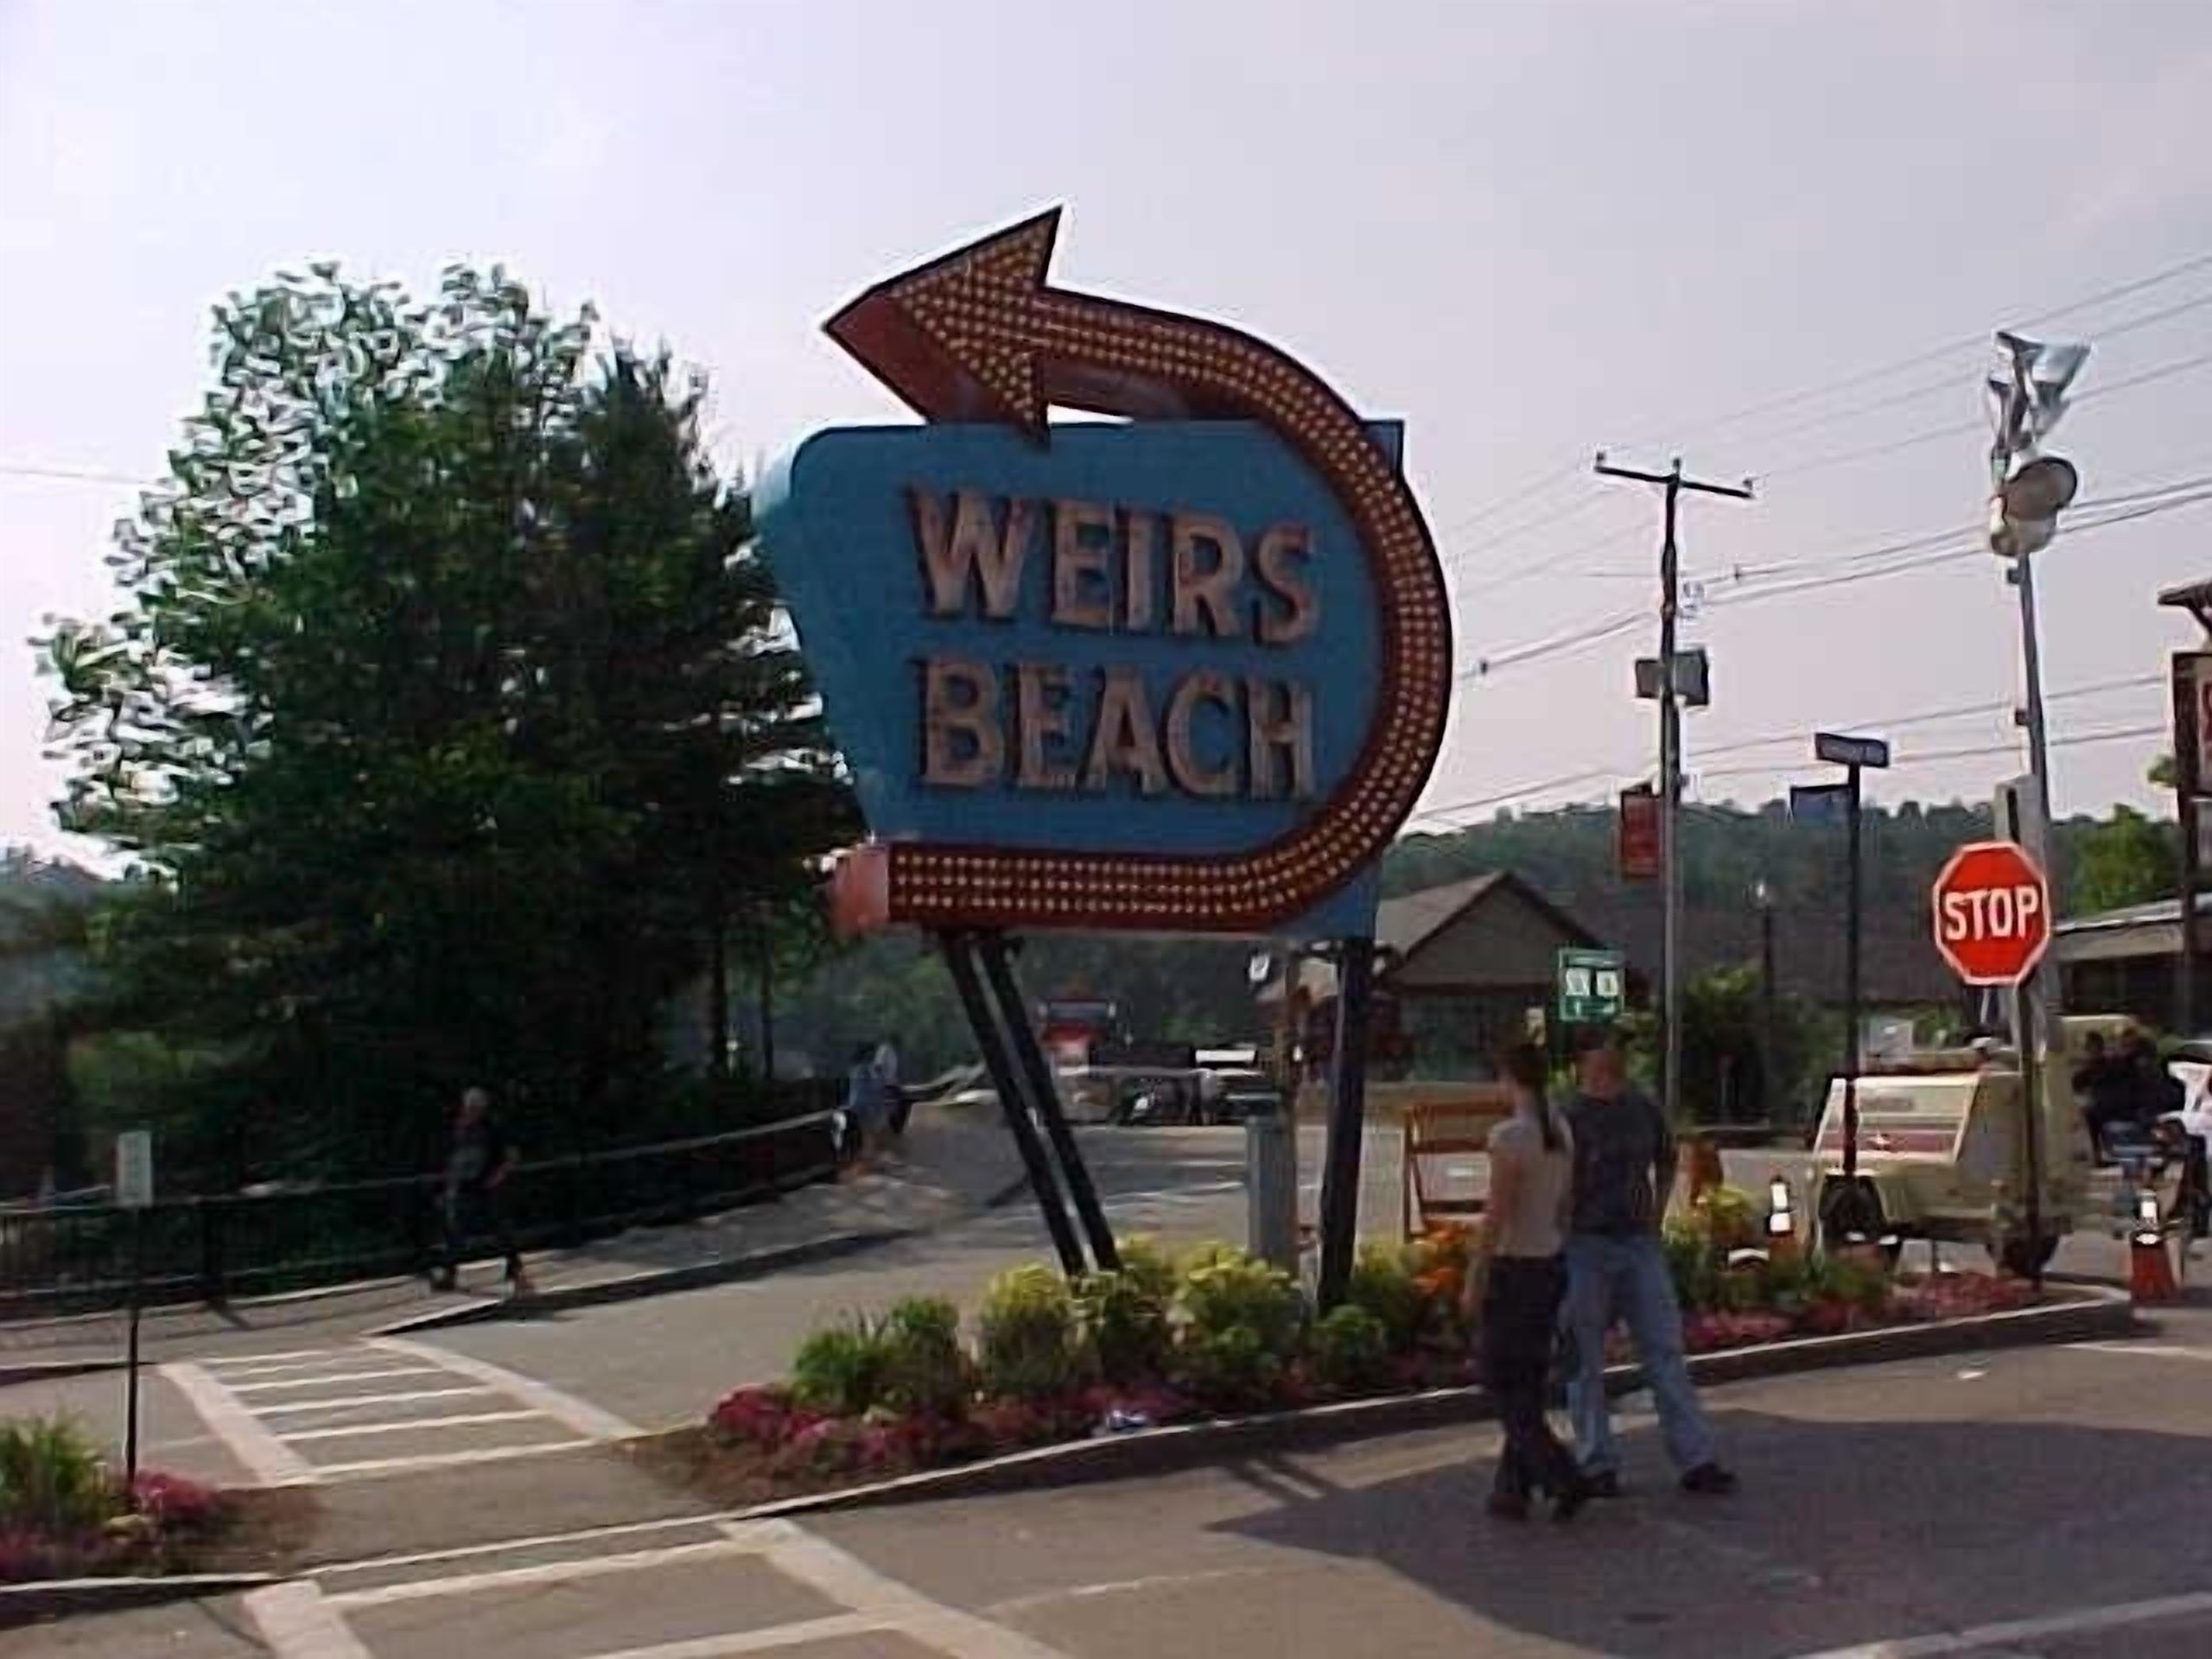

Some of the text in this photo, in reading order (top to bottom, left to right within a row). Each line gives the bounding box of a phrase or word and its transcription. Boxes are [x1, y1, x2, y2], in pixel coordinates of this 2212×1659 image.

[906, 487, 1321, 646] WEIRS
[914, 655, 1319, 801] BEACH
[1945, 884, 2039, 941] STOP
